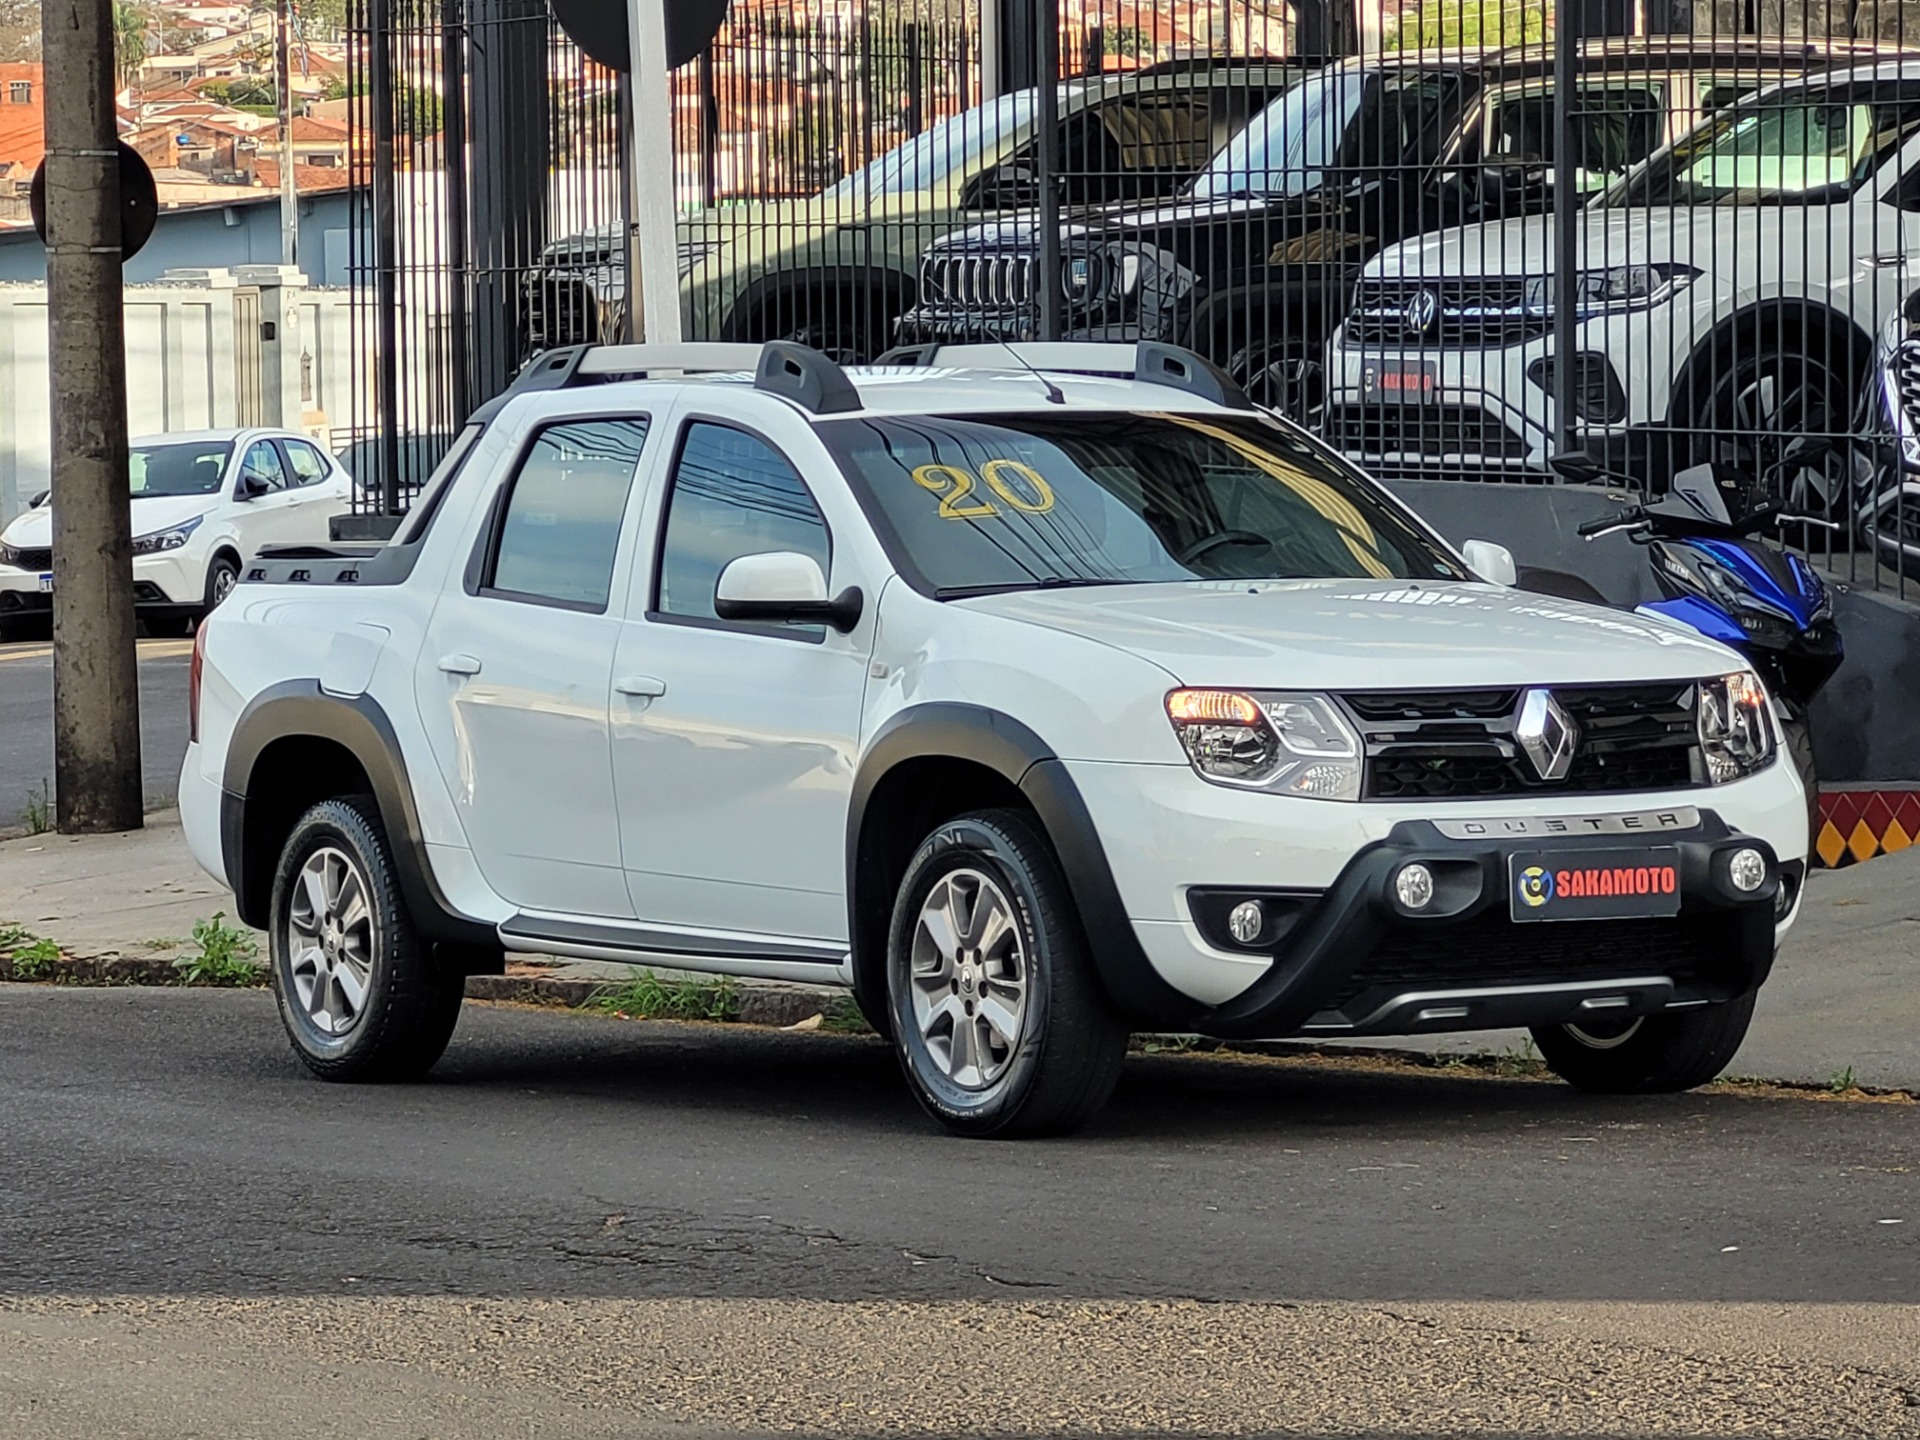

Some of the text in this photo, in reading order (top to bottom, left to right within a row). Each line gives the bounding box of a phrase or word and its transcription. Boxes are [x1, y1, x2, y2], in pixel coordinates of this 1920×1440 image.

[912, 459, 1055, 520] 20
[1464, 813, 1679, 834] DUSTER
[1556, 866, 1675, 897] SAKAMOTO
